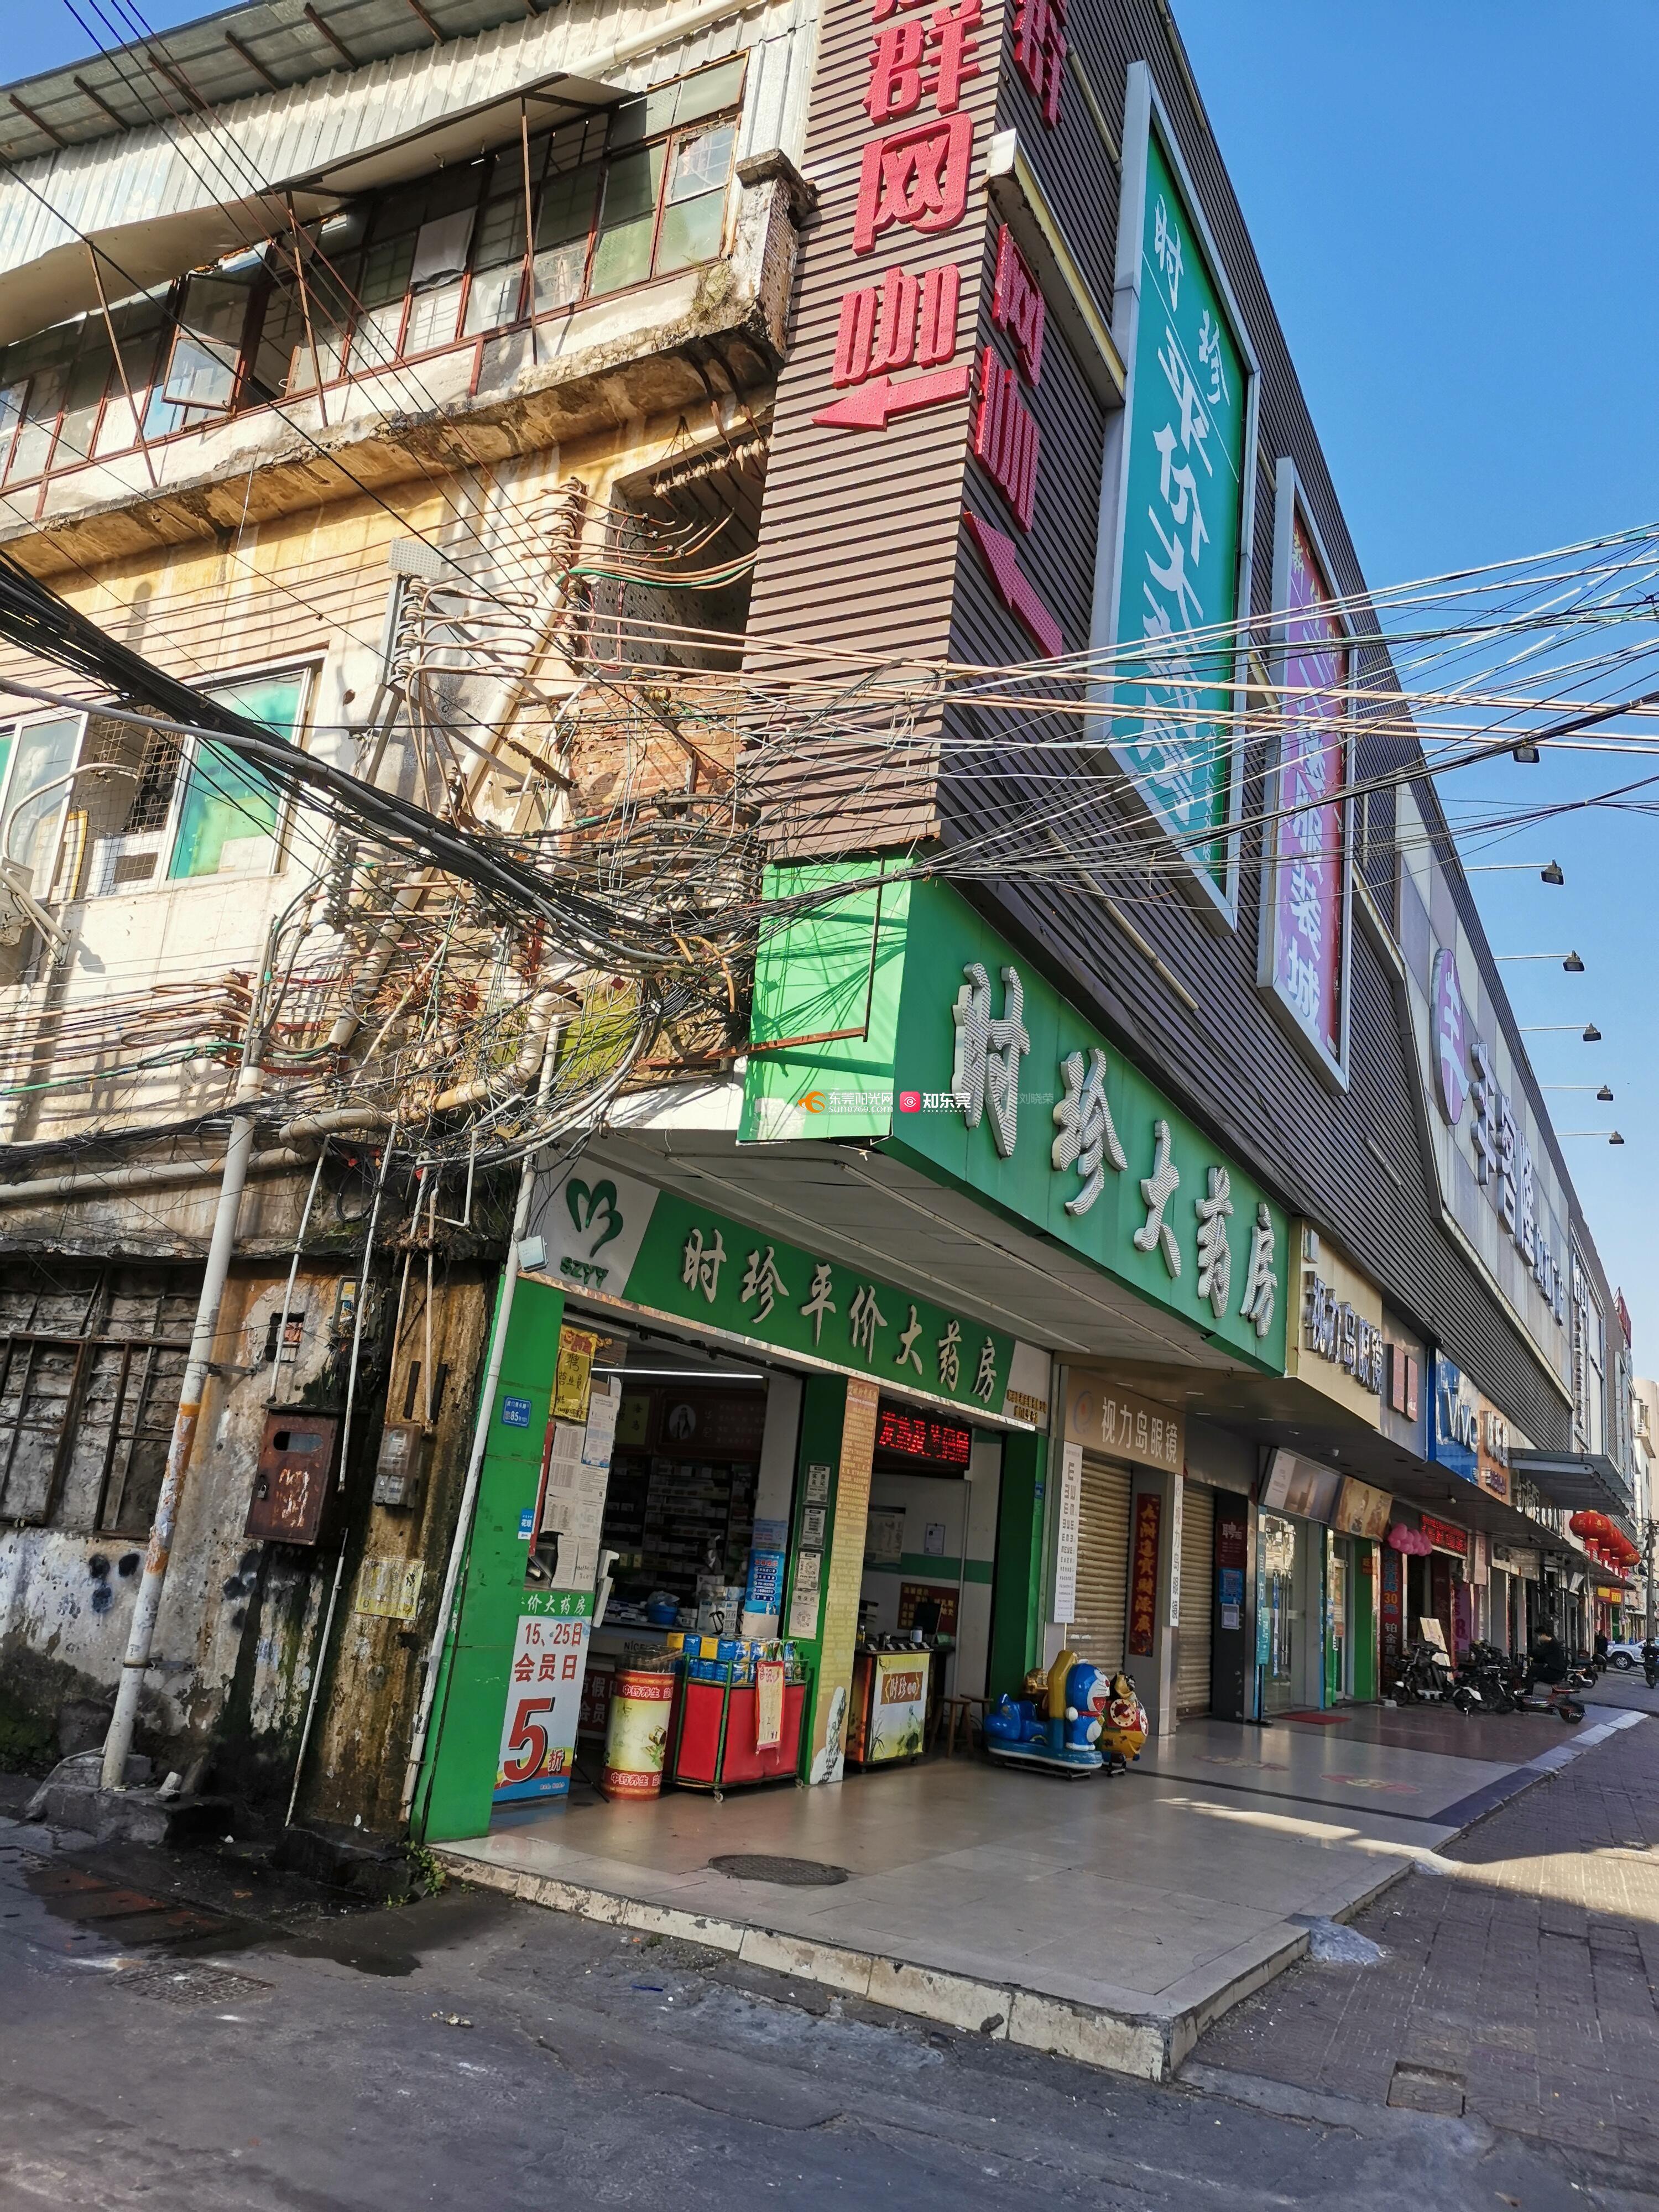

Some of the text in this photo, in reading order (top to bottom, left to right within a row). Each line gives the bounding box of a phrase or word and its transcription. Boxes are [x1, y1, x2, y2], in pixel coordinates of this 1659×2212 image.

[832, 0, 982, 388] 群网咖
[1154, 194, 1230, 407] 时珍
[1141, 325, 1212, 827] 平价大药房
[952, 962, 1278, 1337] 时珍大药房
[560, 1256, 609, 1289] SZYY
[682, 1228, 998, 1404] 时珍平价大药房
[1101, 1396, 1178, 1465] 视力岛眼镜
[521, 1594, 586, 1615] 价大药房
[525, 1623, 583, 1647] 15、25日
[515, 1653, 578, 1683] 会员日
[623, 1684, 660, 1699] 中药养生
[611, 1772, 649, 1786] 中药养生
